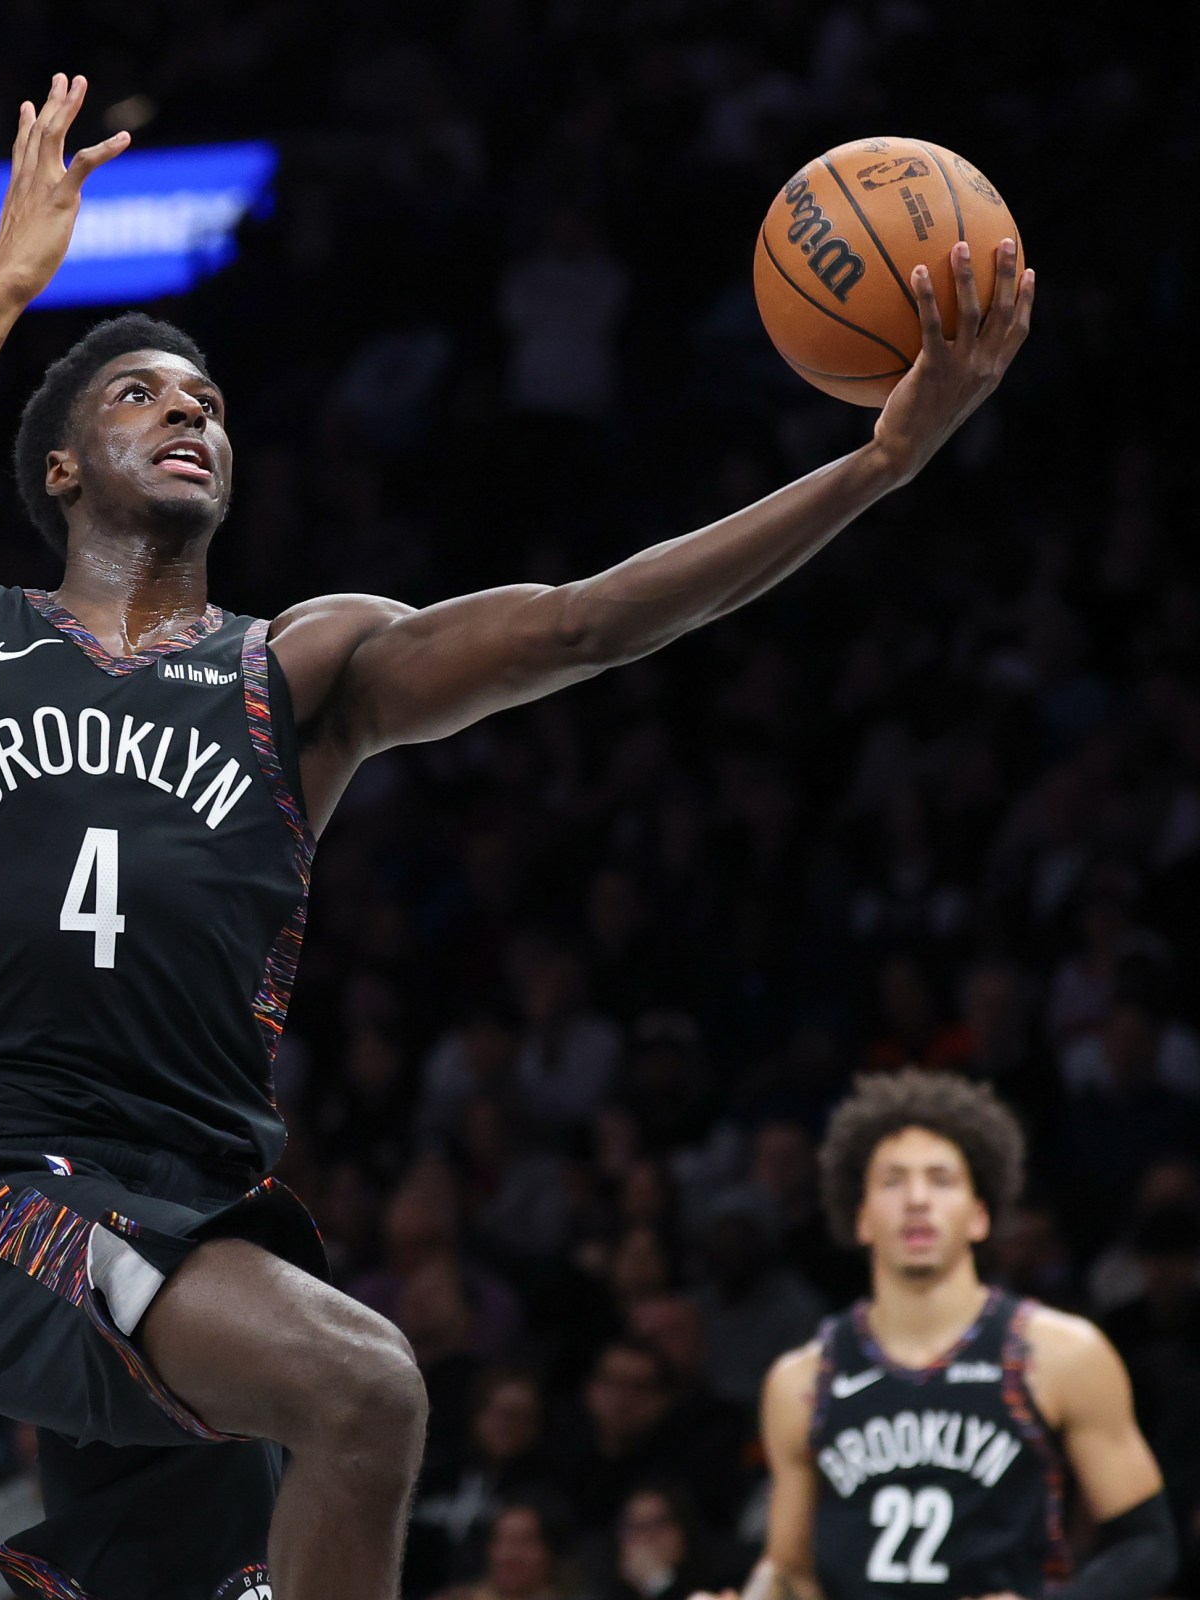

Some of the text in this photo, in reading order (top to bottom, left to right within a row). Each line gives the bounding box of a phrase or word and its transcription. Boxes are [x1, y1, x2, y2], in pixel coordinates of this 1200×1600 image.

[164, 664, 238, 685] All In Won
[59, 826, 126, 969] 4
[817, 1409, 1022, 1498] BROOKLYN
[866, 1485, 953, 1584] 22
